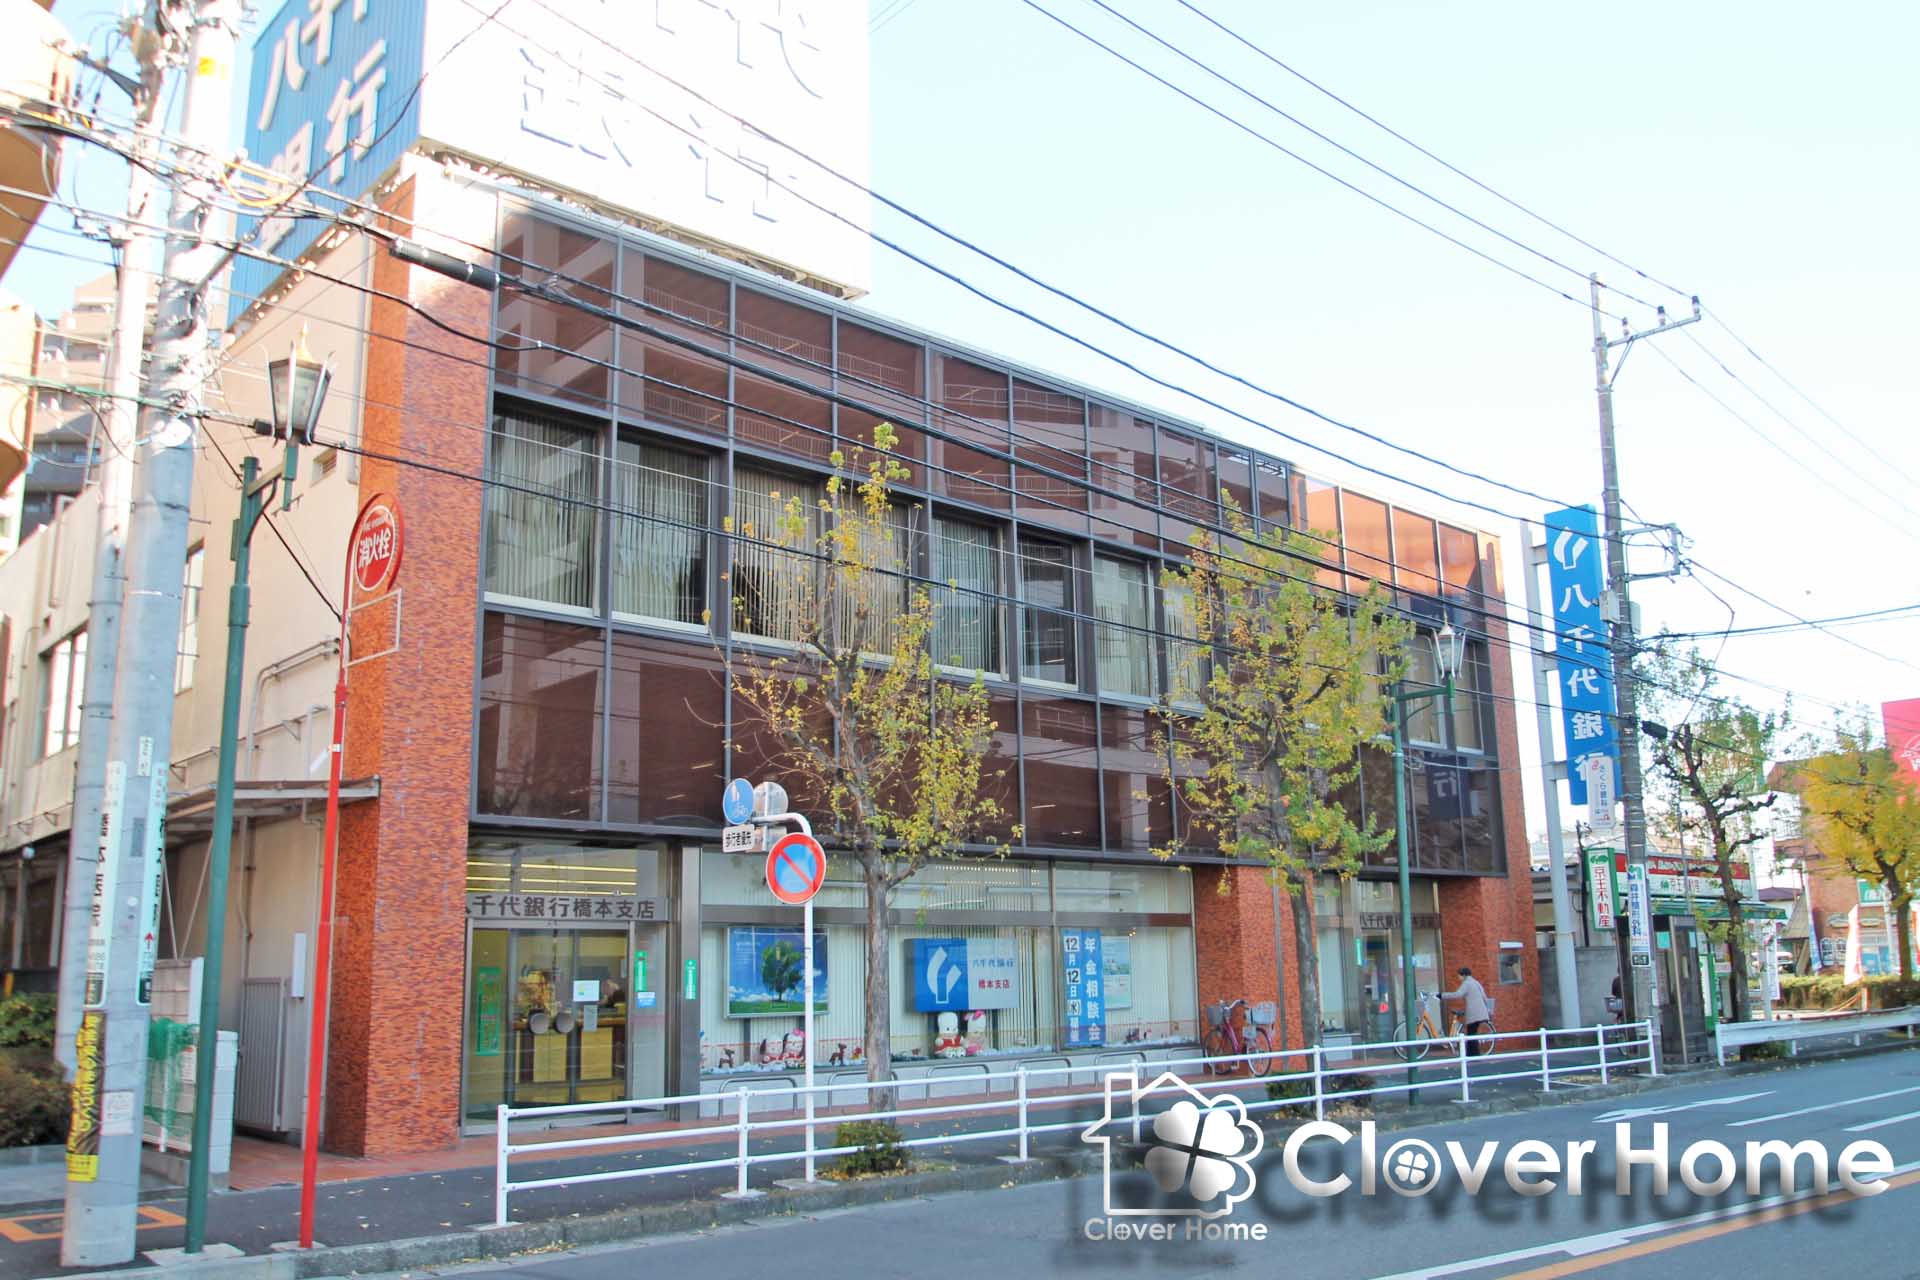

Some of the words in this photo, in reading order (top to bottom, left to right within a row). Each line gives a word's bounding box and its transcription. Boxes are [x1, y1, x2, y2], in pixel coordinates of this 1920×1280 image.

[358, 527, 391, 570] 消火栓
[464, 894, 656, 919] 千代銀行橋本支店
[1084, 938, 1100, 1041] 年金相談会
